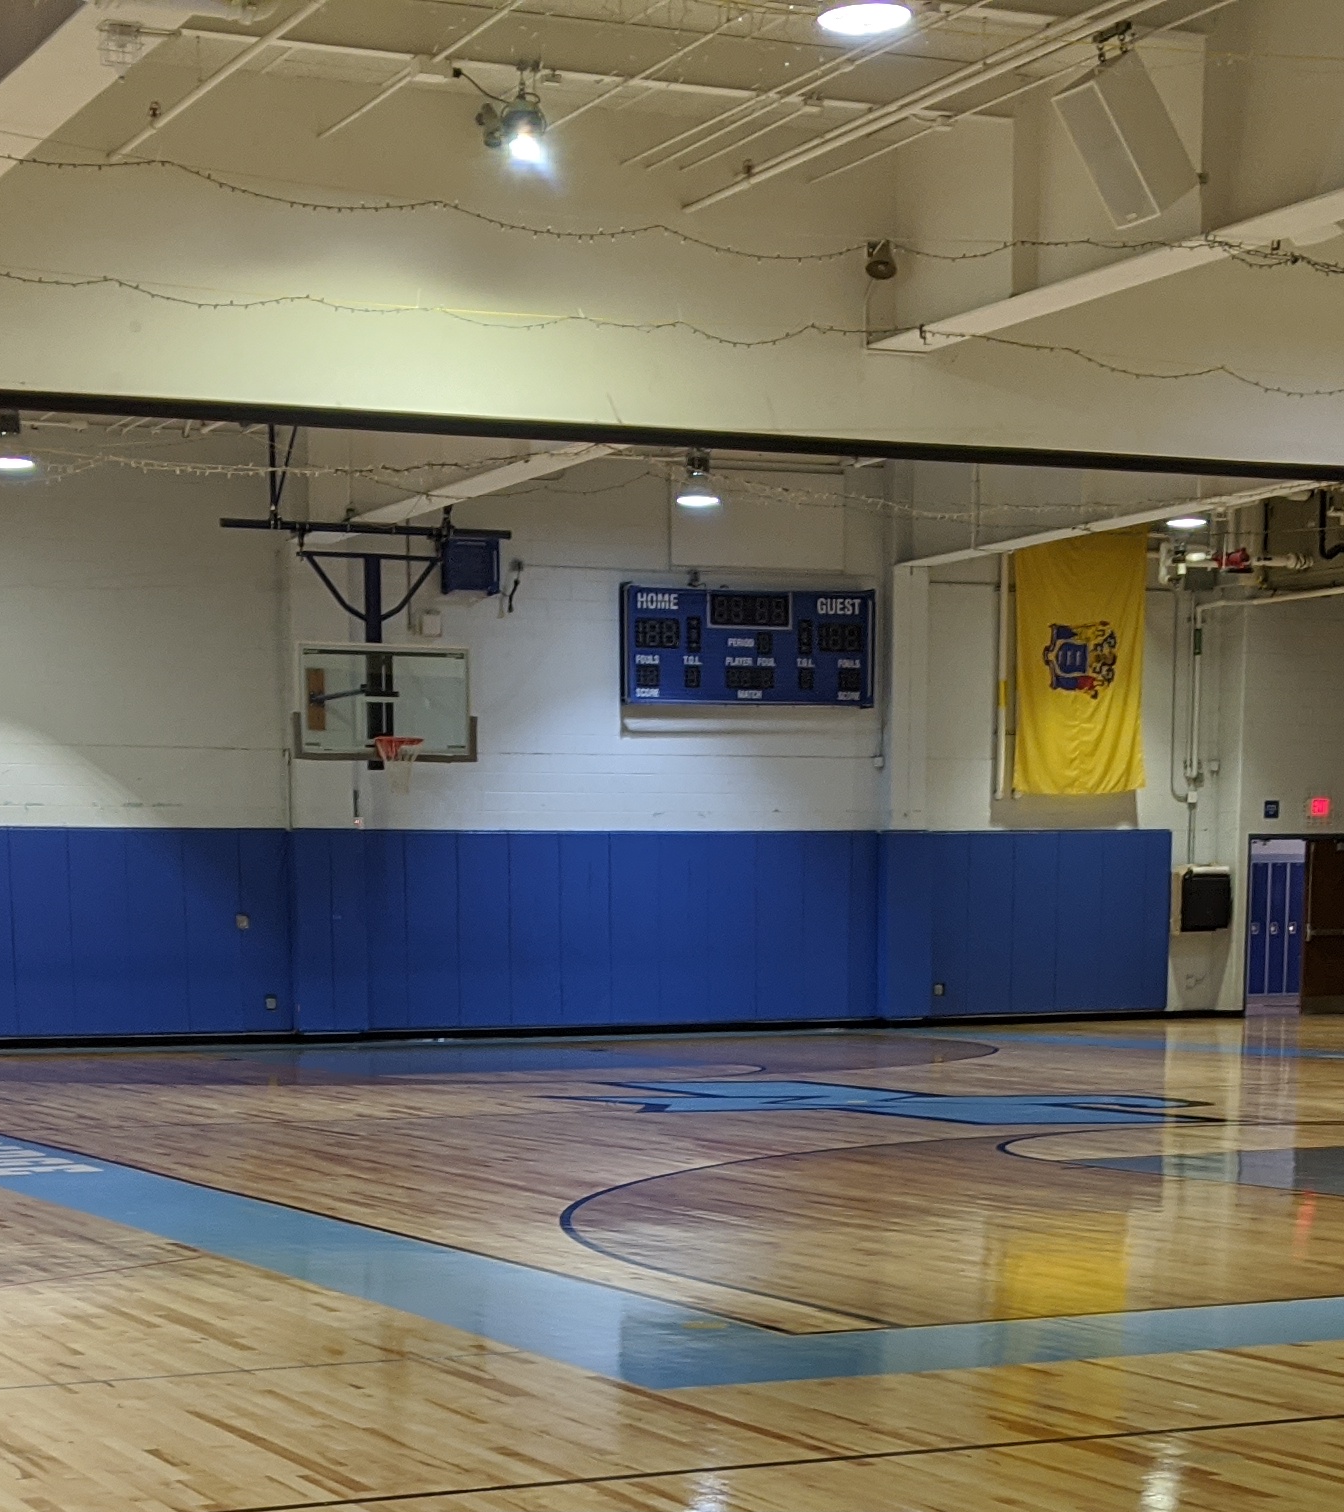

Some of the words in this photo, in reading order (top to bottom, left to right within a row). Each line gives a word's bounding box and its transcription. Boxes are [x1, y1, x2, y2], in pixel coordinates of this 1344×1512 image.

[637, 593, 679, 610] HOME
[816, 598, 861, 615] GUEST
[727, 638, 754, 648] PERIOD
[635, 654, 660, 665] FOULS
[725, 656, 753, 666] PLAYER
[756, 657, 776, 667] FOUL
[837, 659, 861, 669] FOULS
